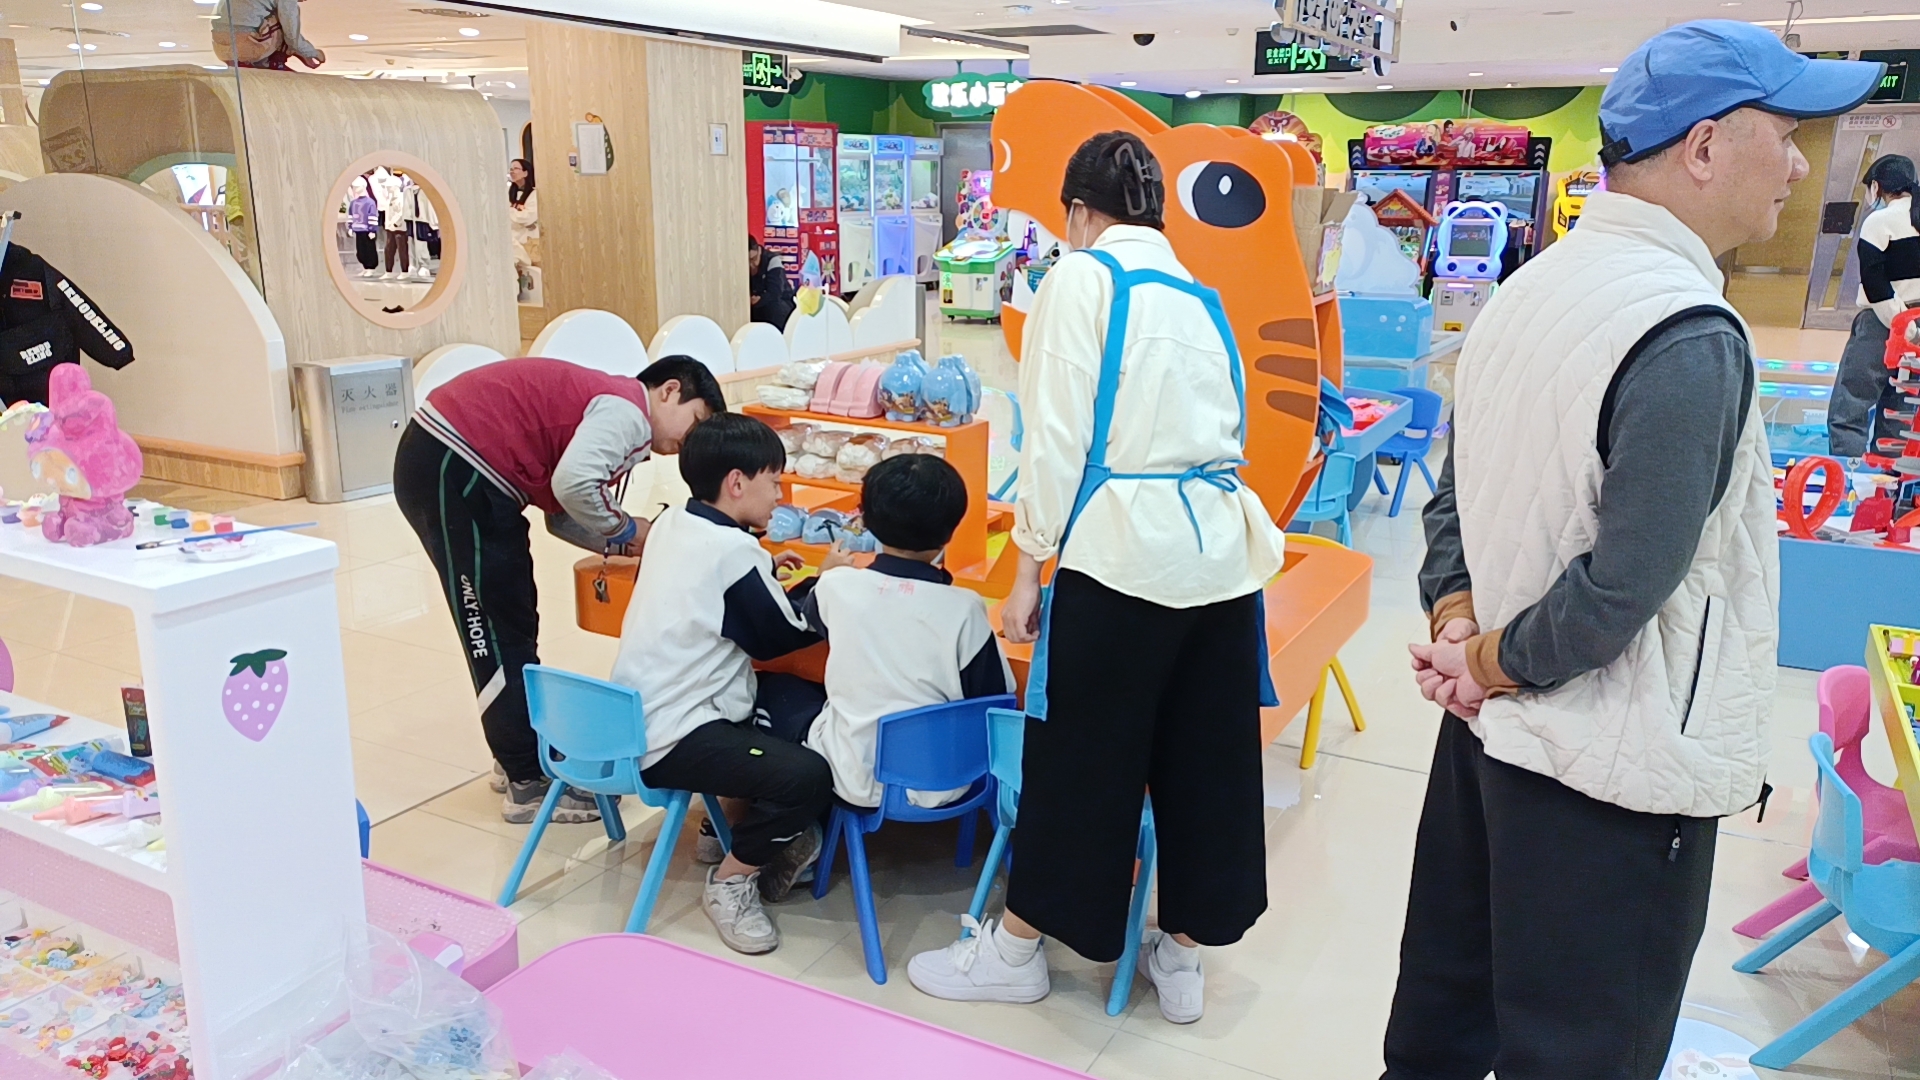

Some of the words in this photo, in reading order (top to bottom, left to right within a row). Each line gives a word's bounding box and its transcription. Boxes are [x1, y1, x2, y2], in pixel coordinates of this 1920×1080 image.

[1267, 57, 1289, 65] EXIT
[1879, 75, 1899, 88] XIT
[340, 382, 398, 403] 灭火器
